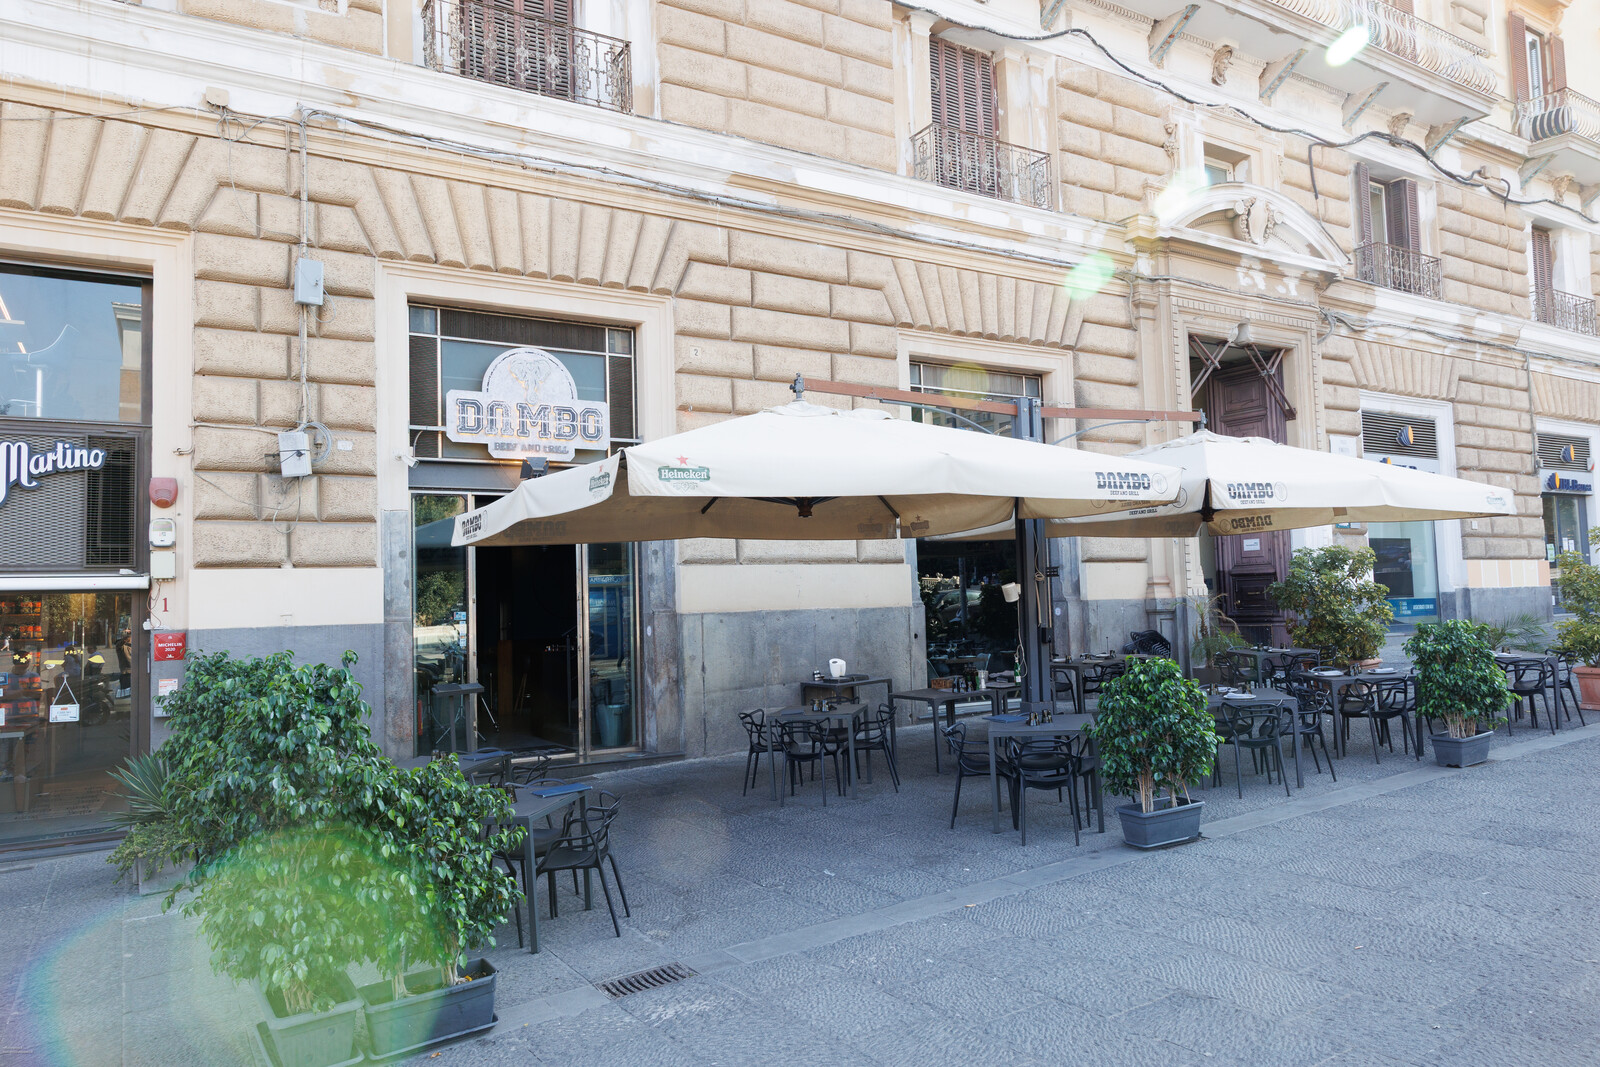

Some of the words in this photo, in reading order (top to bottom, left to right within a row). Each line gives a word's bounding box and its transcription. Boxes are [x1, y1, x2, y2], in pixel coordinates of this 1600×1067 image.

[456, 398, 603, 442] DAMBO
[520, 443, 541, 453] AND
[0, 441, 105, 504] Martino
[661, 469, 708, 480] Heineken
[1095, 472, 1151, 490] DAMBO
[1227, 482, 1274, 500] DAMBO
[162, 597, 169, 613] 1
